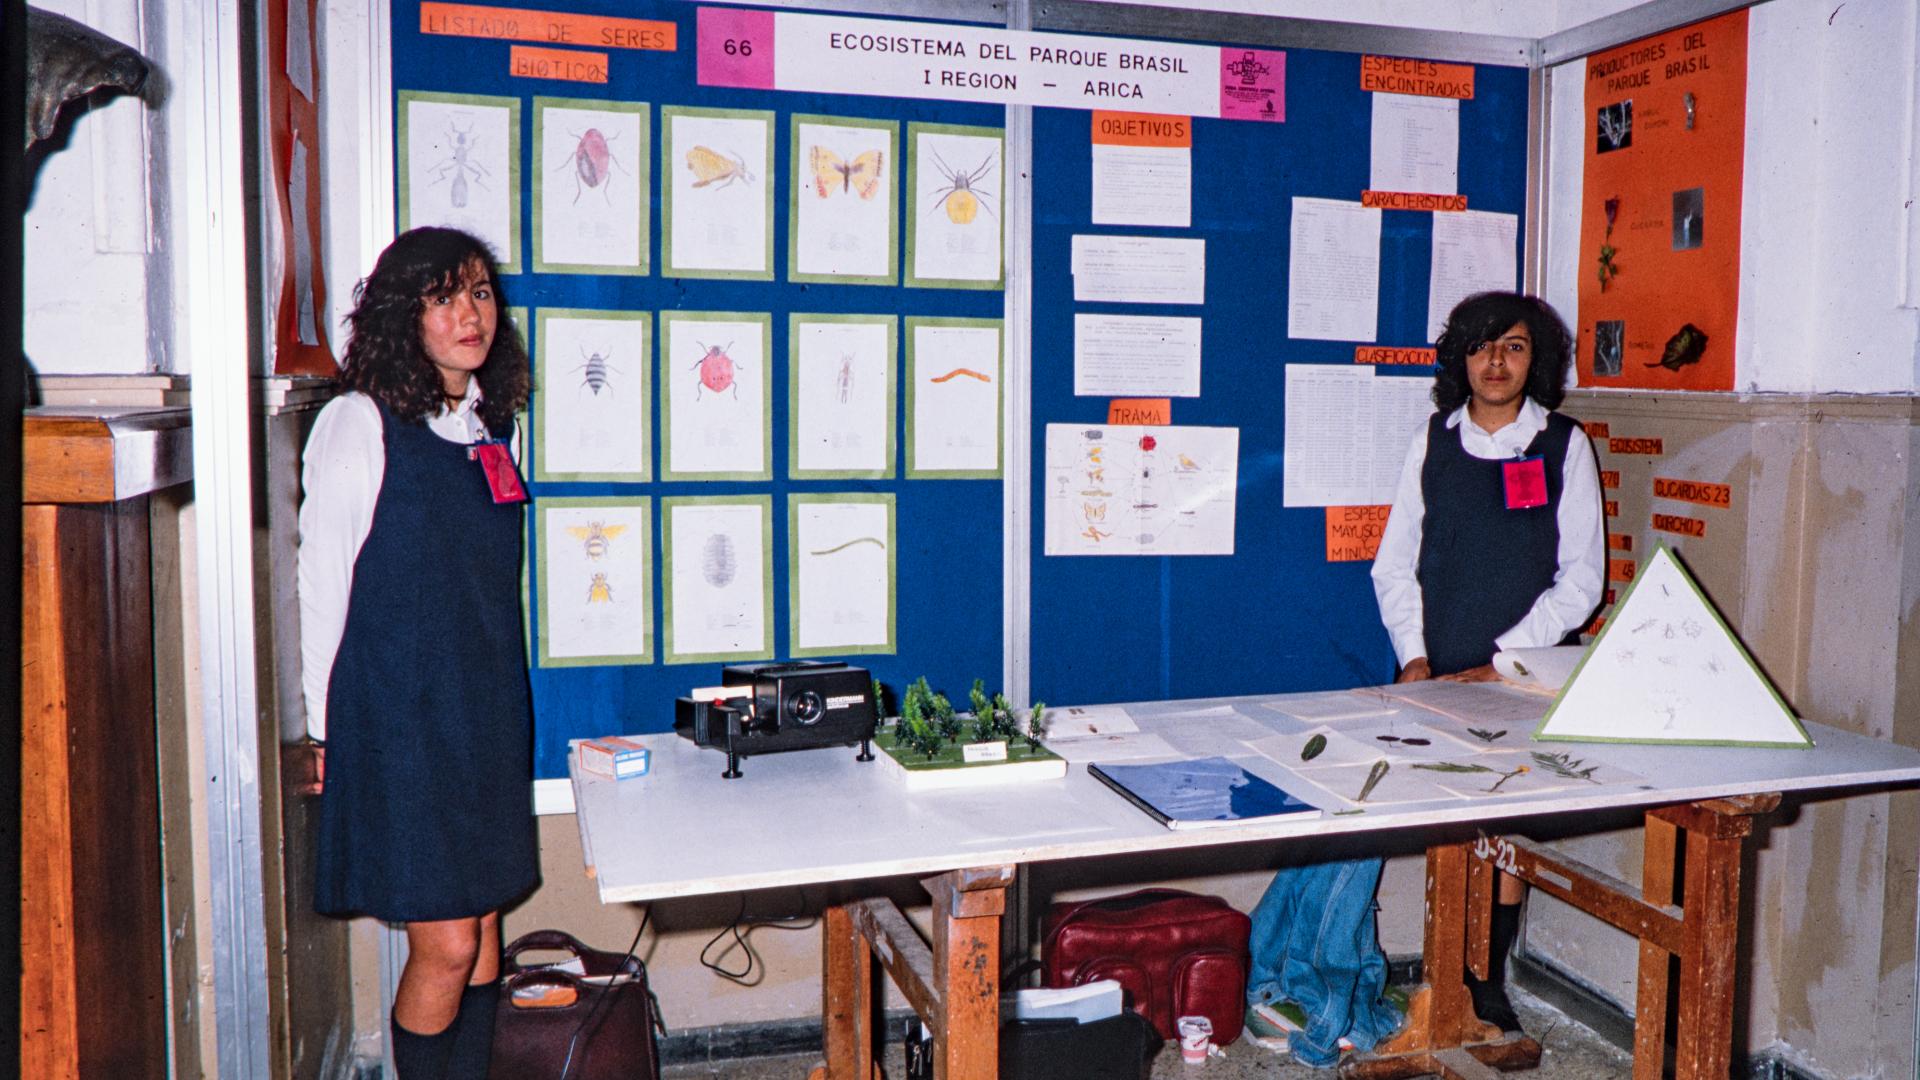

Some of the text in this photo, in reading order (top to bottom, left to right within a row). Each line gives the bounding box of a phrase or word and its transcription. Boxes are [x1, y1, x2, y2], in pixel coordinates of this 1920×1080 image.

[547, 23, 574, 43] DE
[600, 27, 666, 49] SERES
[723, 38, 753, 57] 66
[829, 32, 1189, 74] ECOSISTEMA DEL PARQUE BRASIL
[1590, 32, 1706, 80] PRODUCTORES DEL
[1362, 54, 1438, 77] ESPECIES
[1608, 58, 1710, 94] PARQUE BRASIL
[923, 70, 931, 86] I
[940, 71, 1018, 92] REGION
[1083, 79, 1144, 100] ARICA
[1365, 74, 1472, 98] ENCONTRADAS
[1101, 118, 1185, 139] OBJETIVOS
[1113, 408, 1161, 425] TRAMA
[1713, 486, 1731, 503] 23
[1344, 507, 1389, 521] ESPEC
[1696, 520, 1705, 537] 2
[1361, 536, 1368, 549] Y
[1332, 546, 1376, 561] MINUS
